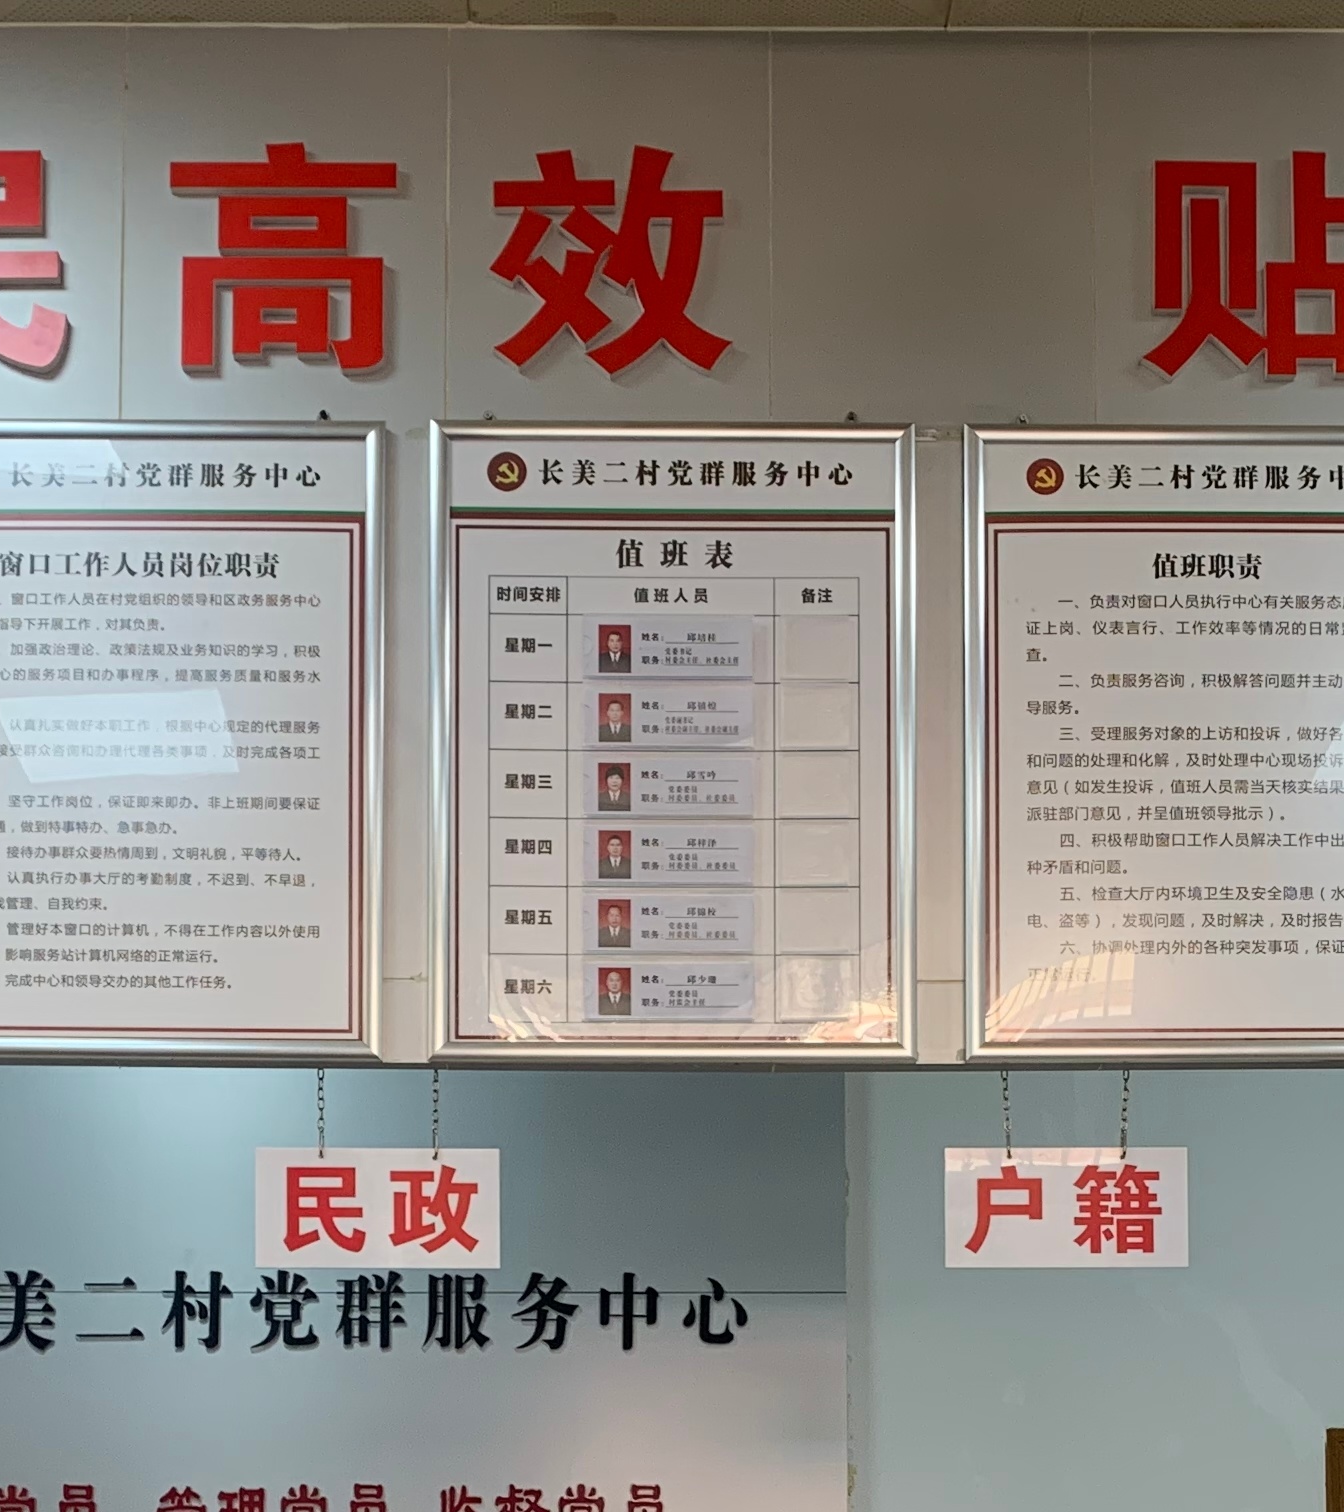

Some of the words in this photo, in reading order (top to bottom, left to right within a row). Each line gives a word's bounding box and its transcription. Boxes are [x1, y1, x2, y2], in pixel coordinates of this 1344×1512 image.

[8, 462, 322, 488] 长美二村党群服务中心
[539, 458, 854, 487] 长美二村党群服务中心
[616, 539, 734, 569] 值班表
[1152, 552, 1263, 580] 值班职责
[496, 586, 561, 603] 时间安排
[634, 587, 708, 603] 值班人员
[801, 587, 833, 603] 备注
[505, 638, 553, 653] 星期一
[505, 704, 552, 719] 星期二
[1026, 700, 1080, 716] 导服务。
[504, 774, 552, 790] 星期三
[1027, 805, 1287, 822] 派驻部门意见，并呈值班领导批示）。
[504, 839, 552, 855] 星期四
[1027, 859, 1129, 875] 种矛盾和问题。
[504, 910, 552, 926] 星期五
[504, 979, 552, 996] 星期六
[281, 1164, 481, 1253] 民政
[963, 1162, 1163, 1255] 户籍
